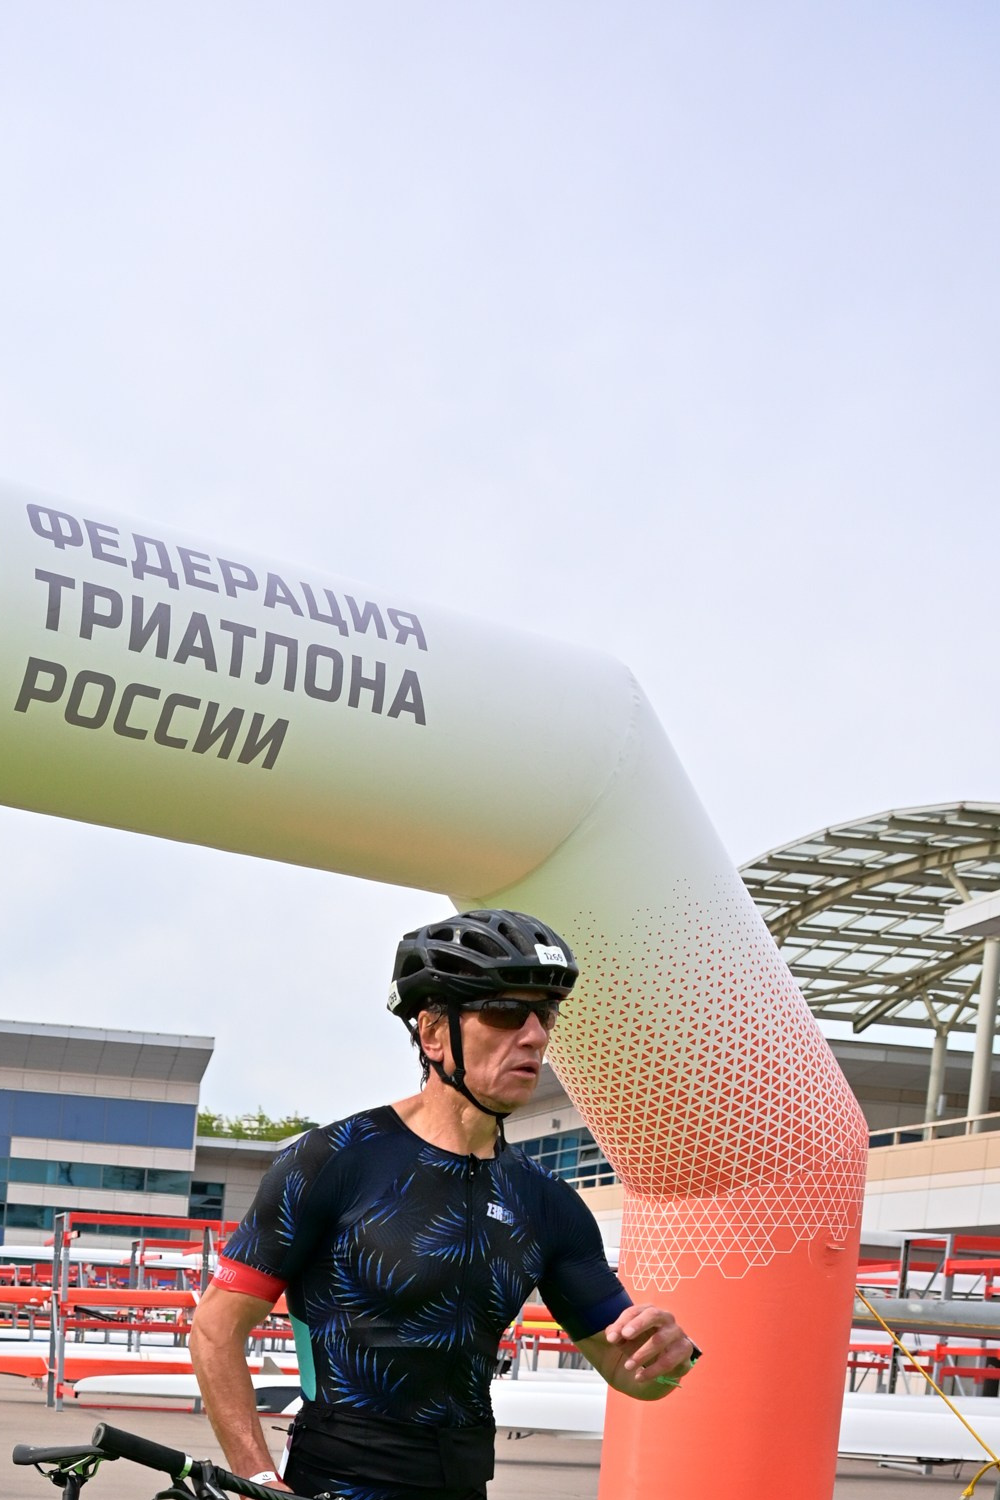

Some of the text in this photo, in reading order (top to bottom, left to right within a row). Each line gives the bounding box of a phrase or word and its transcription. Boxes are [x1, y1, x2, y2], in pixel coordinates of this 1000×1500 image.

[25, 503, 429, 652] ФЕДЕРАЦИЯ
[34, 567, 428, 726] ТРИАТЛОНА
[13, 656, 290, 771] РОССИИ
